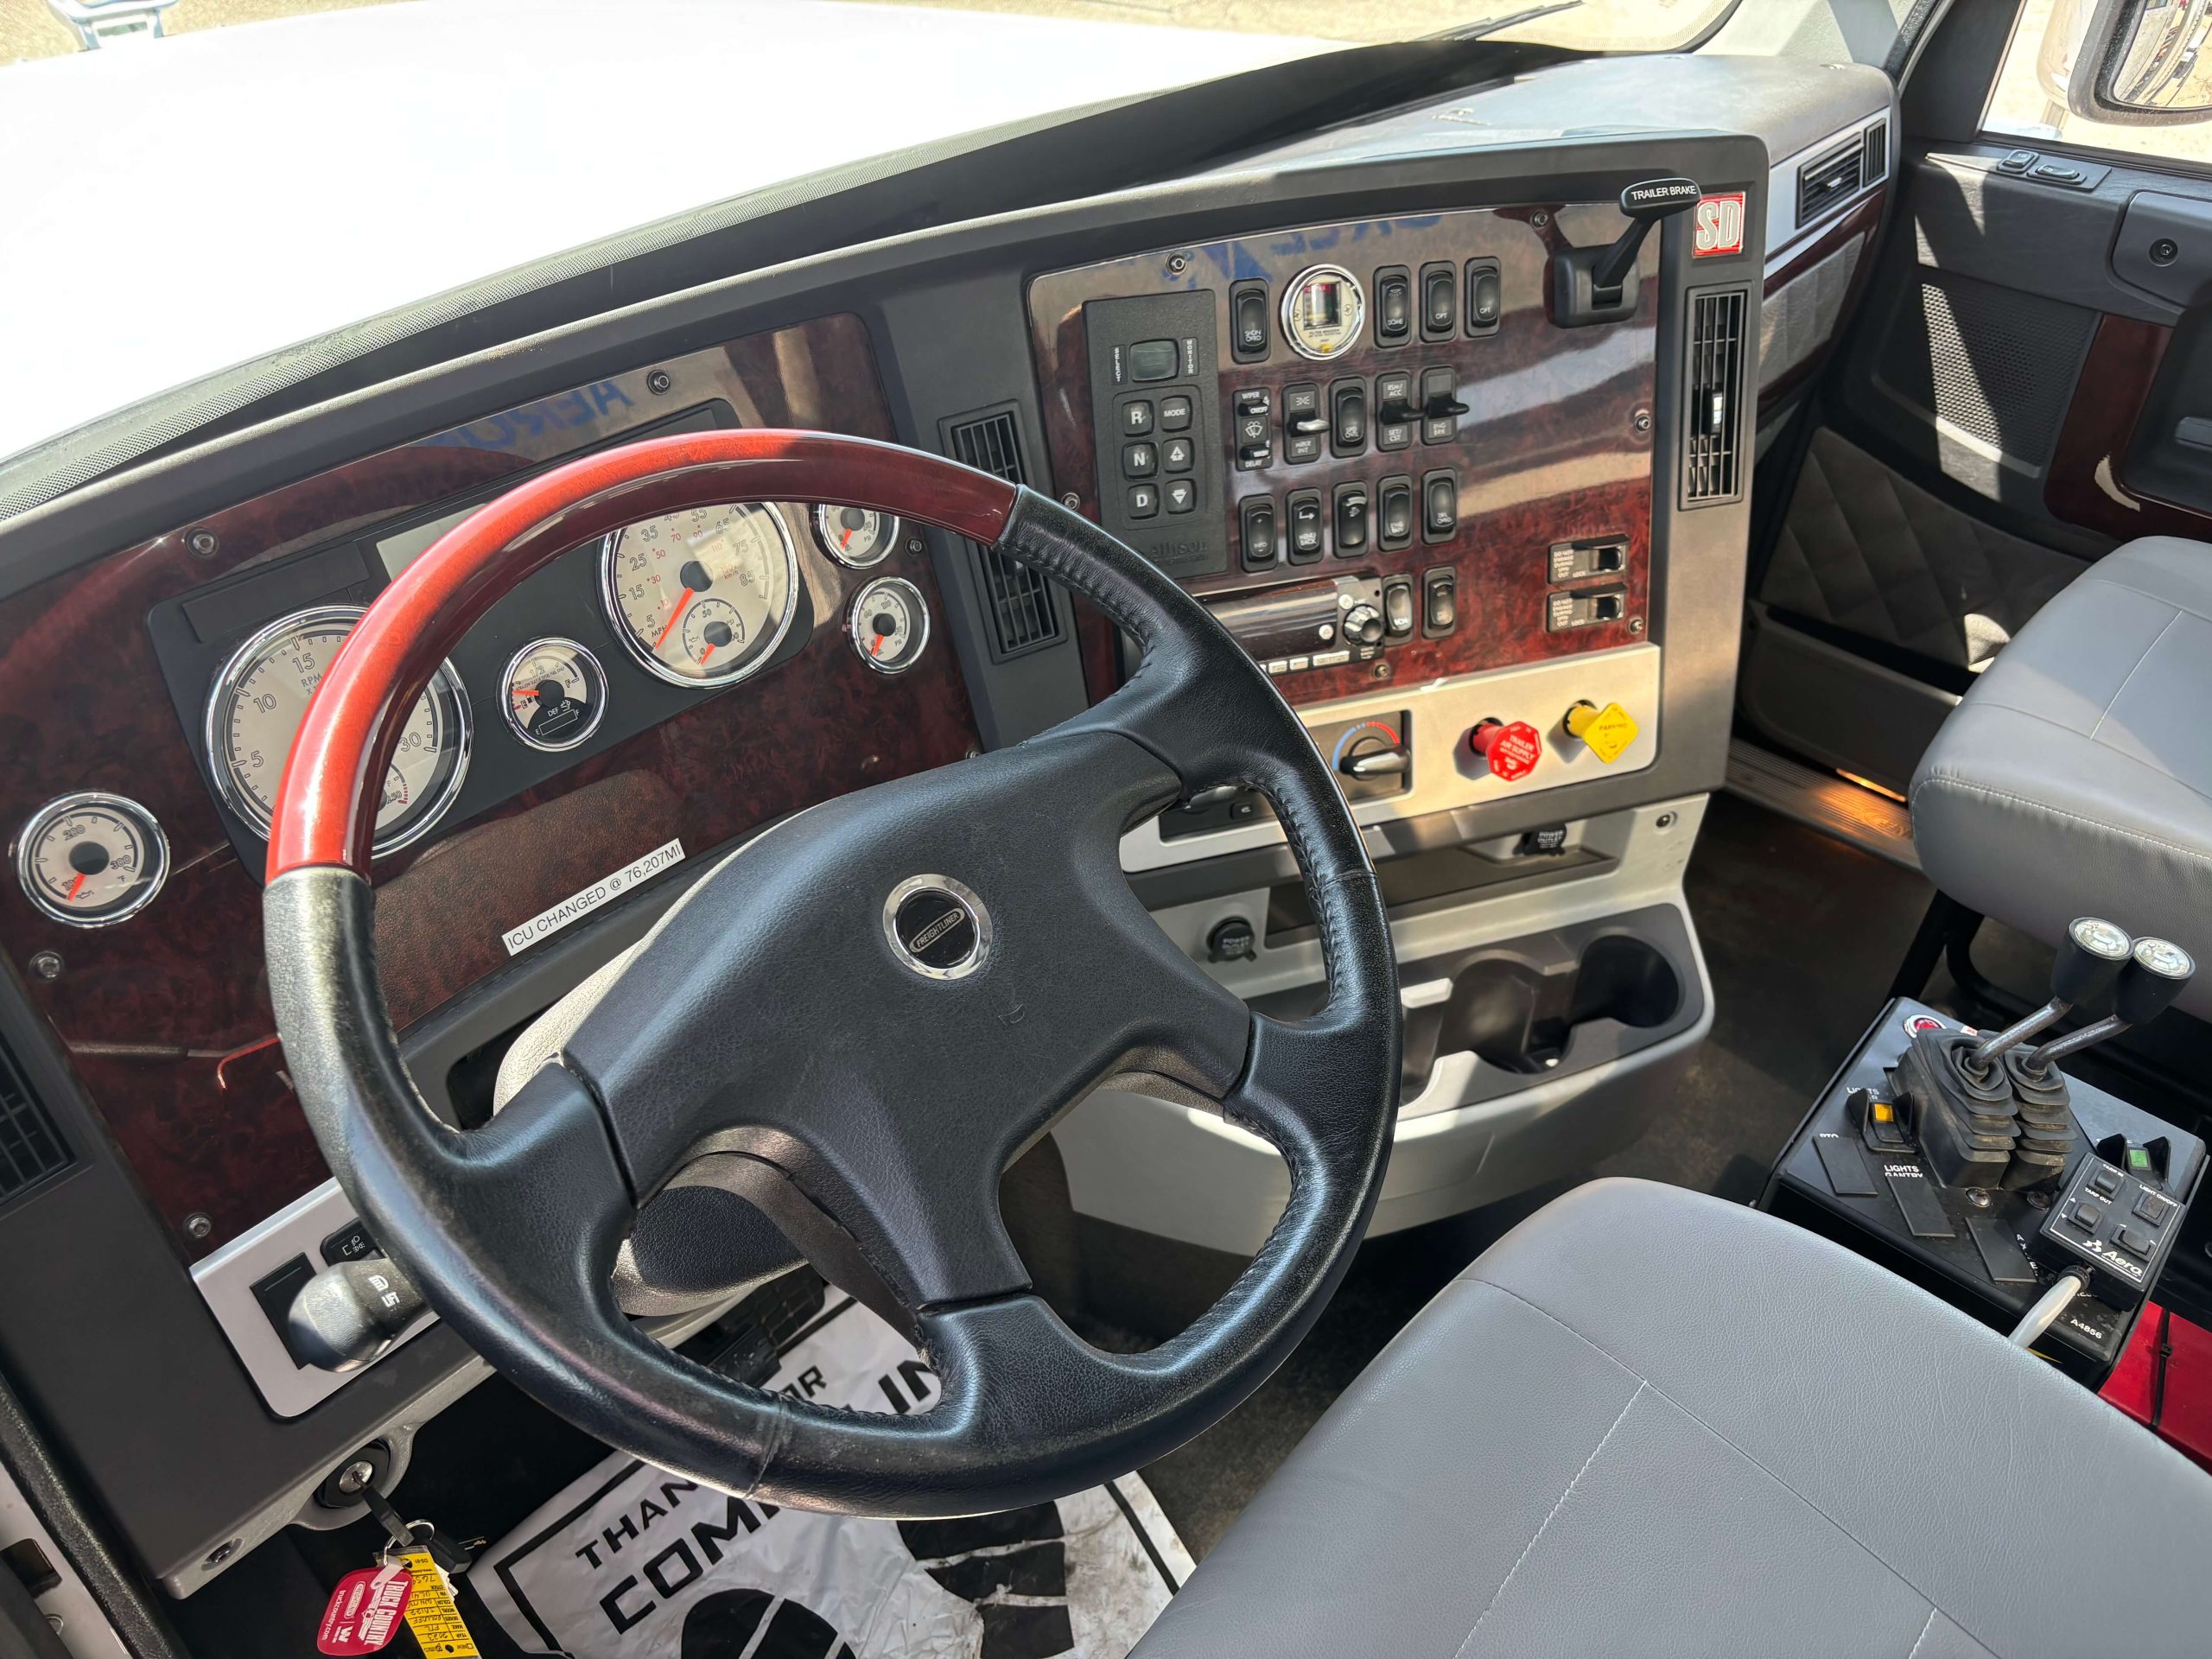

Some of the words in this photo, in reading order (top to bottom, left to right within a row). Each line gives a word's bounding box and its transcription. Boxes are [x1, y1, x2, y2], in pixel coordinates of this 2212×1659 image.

[1631, 186, 1669, 201] TRAILER
[1669, 185, 1697, 197] BRAKE
[1694, 200, 1742, 251] SD
[1435, 312, 1448, 321] OPT
[1479, 307, 1492, 315] OPT
[1130, 410, 1143, 425] R
[1163, 408, 1186, 417] MODE
[1133, 453, 1146, 466] N
[1136, 494, 1148, 507] D
[640, 525, 658, 542] 35
[692, 529, 703, 539] 90
[715, 518, 731, 534] 65
[671, 533, 682, 543] 70
[655, 549, 666, 560] 50
[733, 540, 749, 556] 75
[630, 553, 647, 571] 25
[651, 574, 661, 584] 30
[723, 570, 739, 580] km/h
[740, 570, 755, 586] 85
[629, 584, 645, 600] 15
[702, 608, 712, 618] 50
[646, 614, 656, 629] 5
[292, 652, 315, 673] 15
[530, 664, 545, 678] 1/2
[301, 674, 322, 688] RPM
[564, 679, 570, 689] F
[253, 694, 276, 714] 10
[520, 700, 528, 709] E
[547, 707, 559, 717] DEF
[398, 733, 422, 753] 30
[251, 751, 264, 767] 5
[63, 824, 86, 840] 200
[110, 855, 131, 869] 300
[507, 926, 534, 949] ICU
[537, 887, 606, 932] CHANGED
[609, 877, 622, 891] @
[625, 843, 681, 882] 76,207MI
[916, 912, 960, 948] FREIGHTLINER
[1884, 1165, 1919, 1173] LIGHTS
[2102, 1164, 2118, 1173] TARP
[2084, 1187, 2099, 1198] TARP
[2099, 1195, 2113, 1205] OUT
[2139, 1184, 2157, 1197] LIGHT
[2156, 1193, 2178, 1207] ON/OFF
[2101, 1251, 2143, 1275] Aero
[2070, 1319, 2103, 1339] A4856
[575, 1480, 698, 1570] THAN
[379, 1580, 409, 1607] TRUCK
[321, 1590, 346, 1641] truckcountry.com
[364, 1609, 397, 1645] COUNTRY
